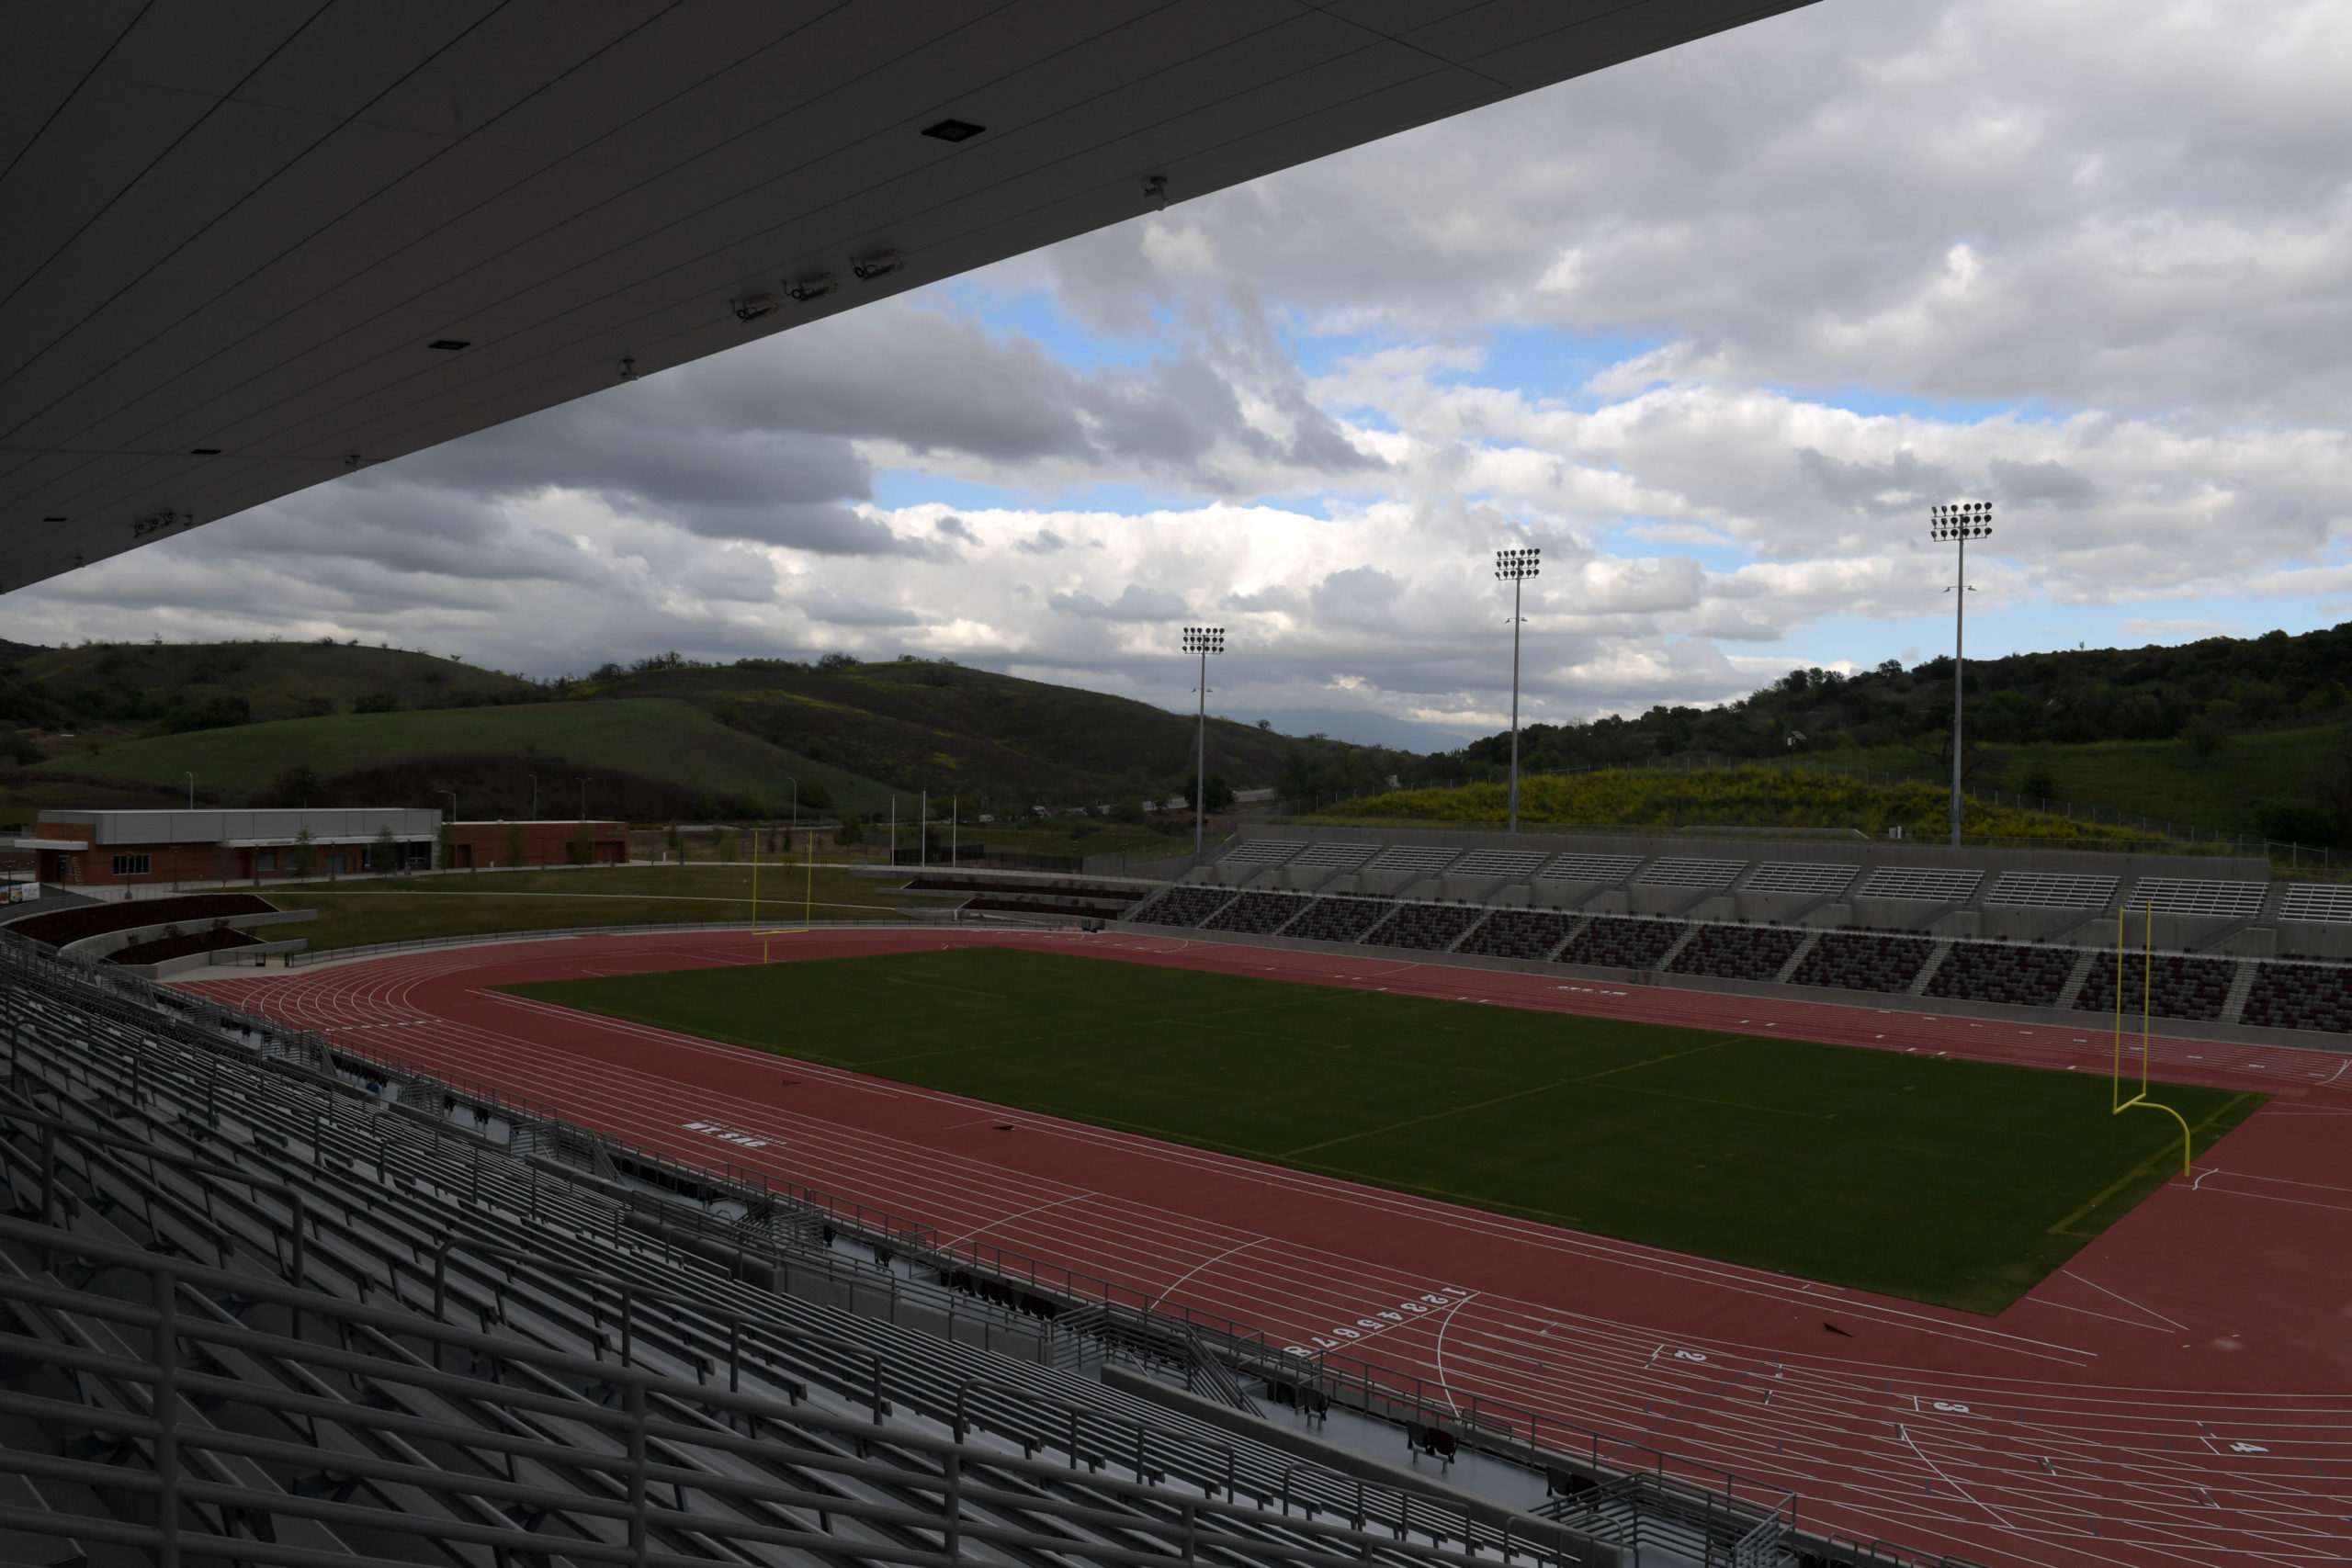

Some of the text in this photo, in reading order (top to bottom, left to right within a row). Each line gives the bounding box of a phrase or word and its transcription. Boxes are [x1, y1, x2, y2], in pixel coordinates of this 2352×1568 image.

[717, 1132, 767, 1147] SAC
[1442, 1286, 1467, 1296] 1
[1420, 1293, 1449, 1305] 2
[1399, 1302, 1429, 1314] 3
[1376, 1310, 1404, 1322] 4
[1356, 1318, 1385, 1330] 5
[1331, 1326, 1361, 1339] 6
[1311, 1336, 1340, 1348] 7
[1283, 1345, 1312, 1358] 8
[1673, 1349, 1707, 1362] 2
[1932, 1401, 1970, 1414] 3
[2228, 1441, 2270, 1453] 4
